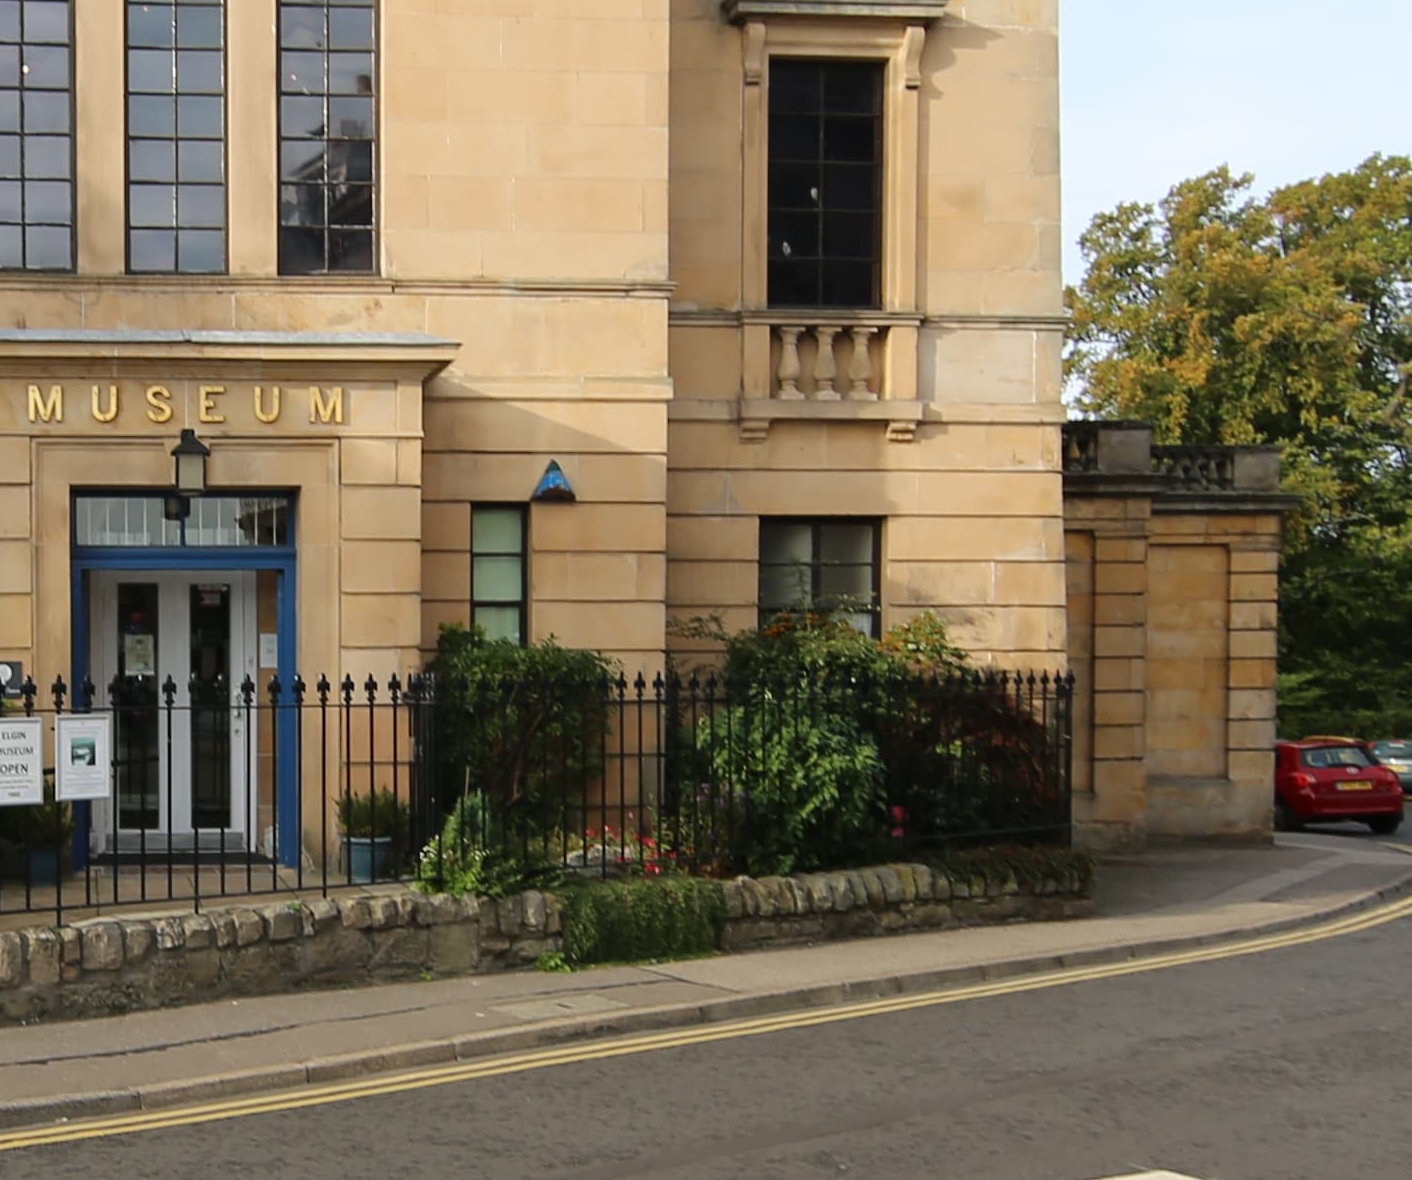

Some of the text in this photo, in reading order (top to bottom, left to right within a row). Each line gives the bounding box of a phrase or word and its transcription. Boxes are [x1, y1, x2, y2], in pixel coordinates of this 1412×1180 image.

[27, 384, 344, 423] MUSEUM
[1, 731, 27, 740] ELGIN
[0, 764, 29, 774] OPEN
